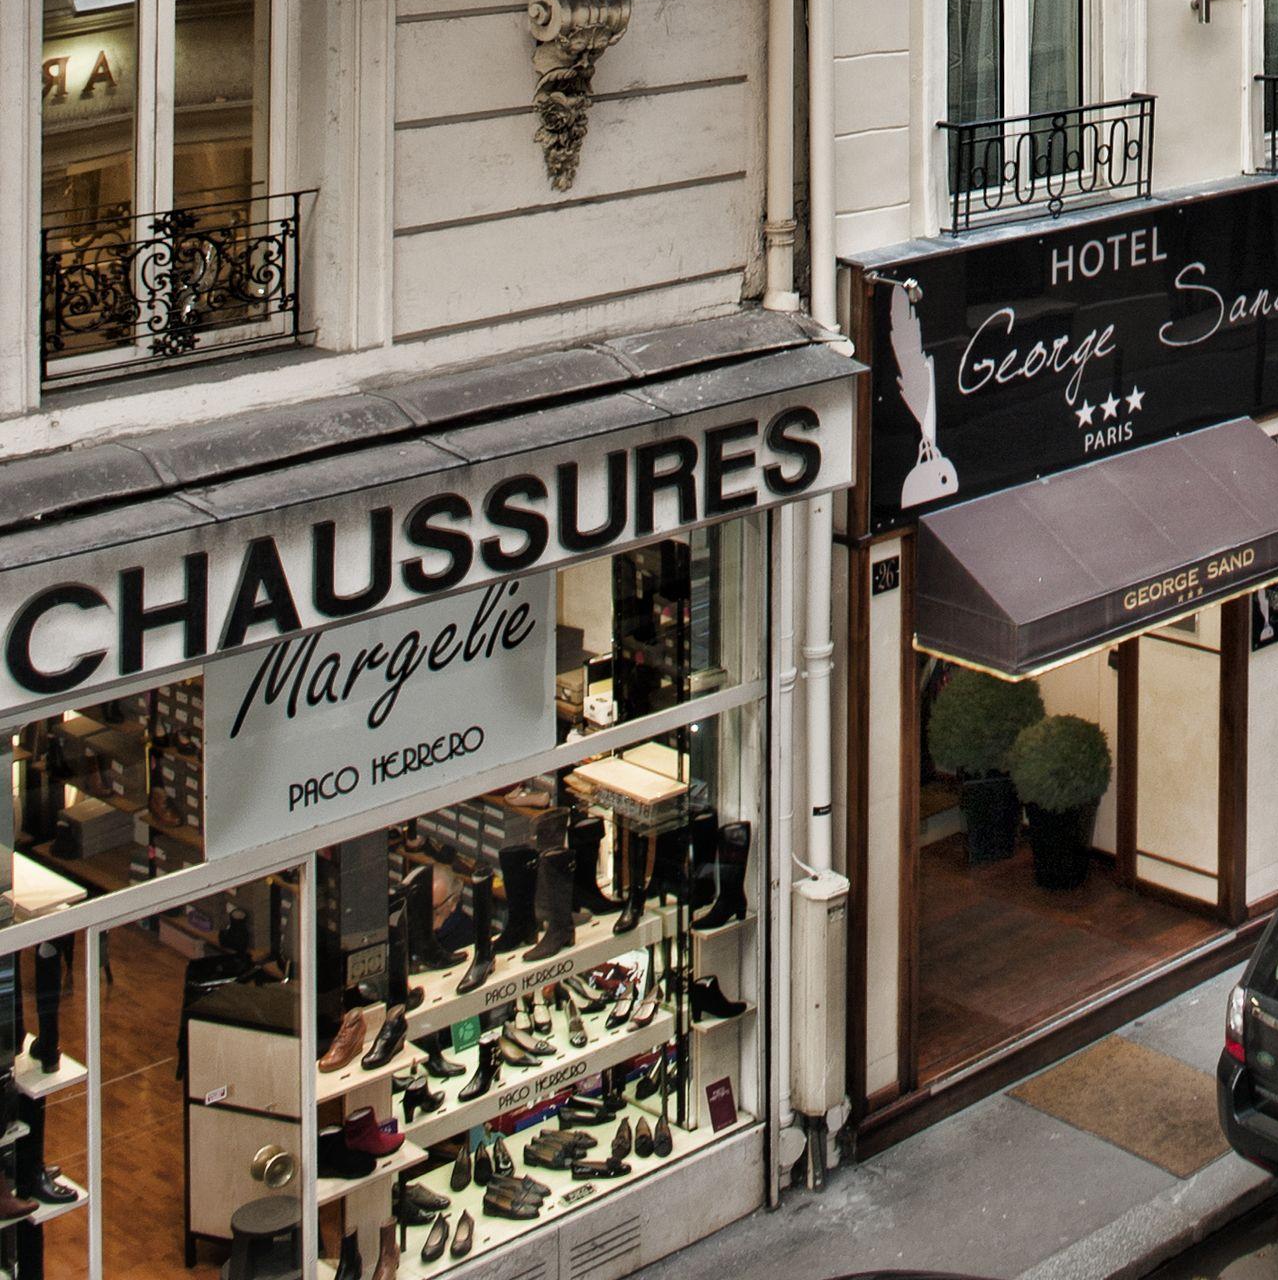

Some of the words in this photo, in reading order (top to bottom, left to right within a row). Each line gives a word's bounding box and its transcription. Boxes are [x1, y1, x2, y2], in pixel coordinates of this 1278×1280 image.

[1051, 226, 1168, 286] HOTEL
[957, 307, 1116, 406] George
[1085, 421, 1134, 453] PARIS
[5, 406, 822, 694] CHAUSSURES
[879, 559, 895, 589] 26
[1123, 567, 1200, 610] GEORGE
[1207, 548, 1255, 579] SAND
[230, 580, 536, 739] Margelie
[289, 766, 360, 812] PACO
[372, 726, 485, 786] HERRERO
[485, 982, 517, 1007] PACO
[522, 959, 574, 989] HERRERO
[498, 1085, 530, 1110] PACO
[535, 1061, 588, 1091] HERRERO
